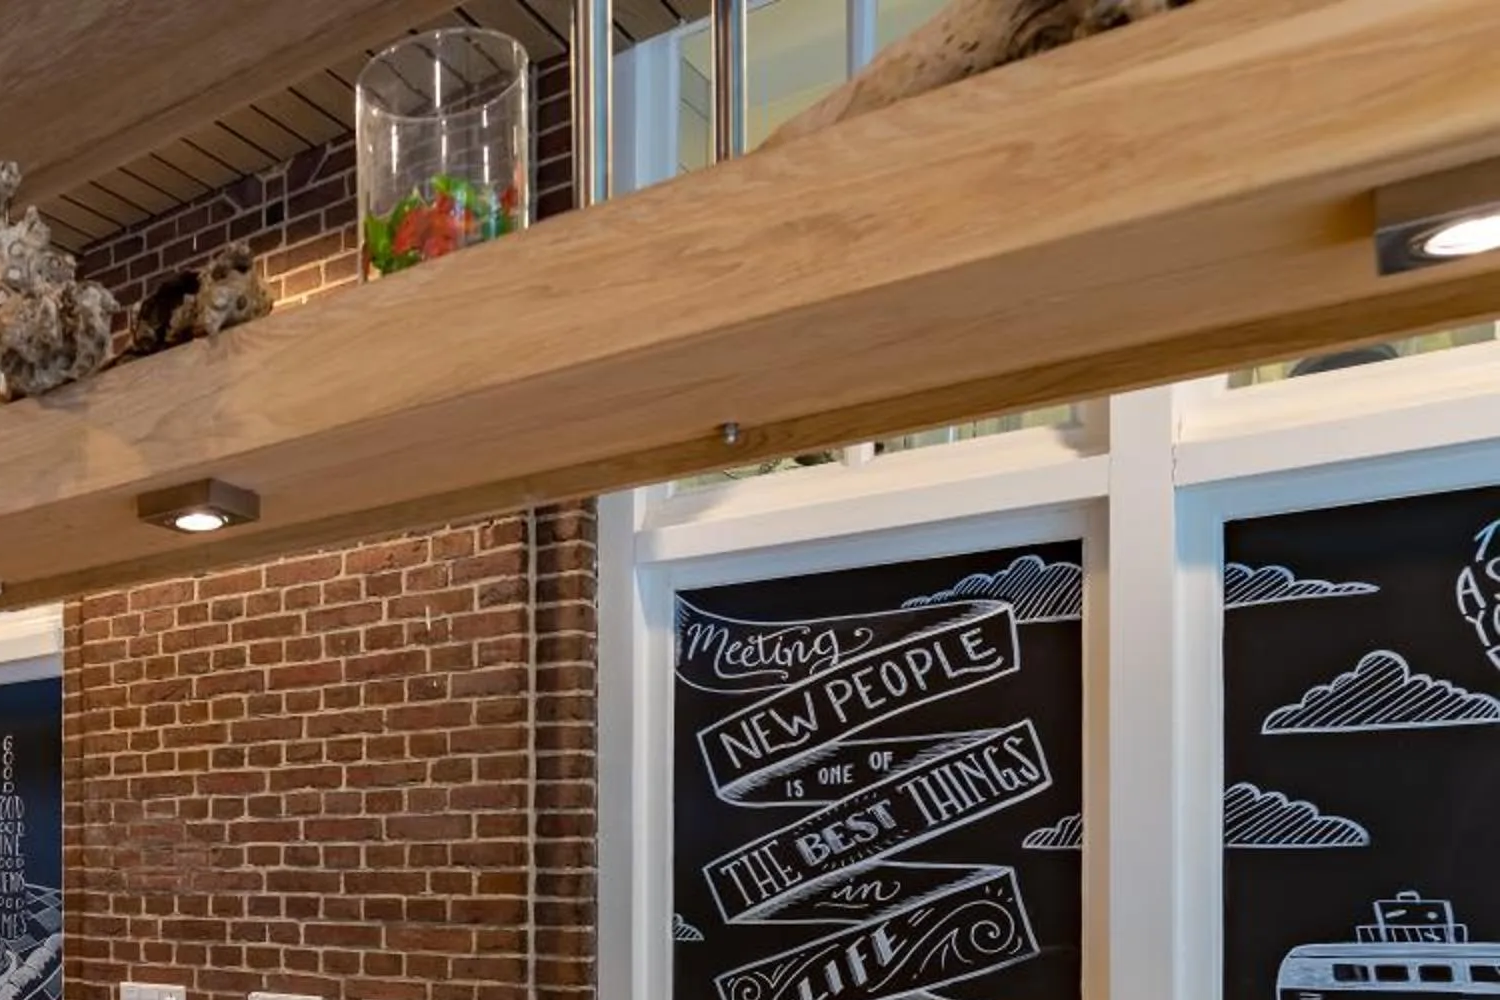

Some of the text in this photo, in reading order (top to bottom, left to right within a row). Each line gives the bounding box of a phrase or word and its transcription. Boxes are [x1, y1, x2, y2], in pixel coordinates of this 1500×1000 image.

[687, 622, 872, 681] Meeting
[719, 627, 1005, 769] NEW PEOPLE
[786, 751, 893, 798] IS ONE OF
[719, 735, 1042, 907] THE BEST THINGS
[830, 878, 901, 901] in
